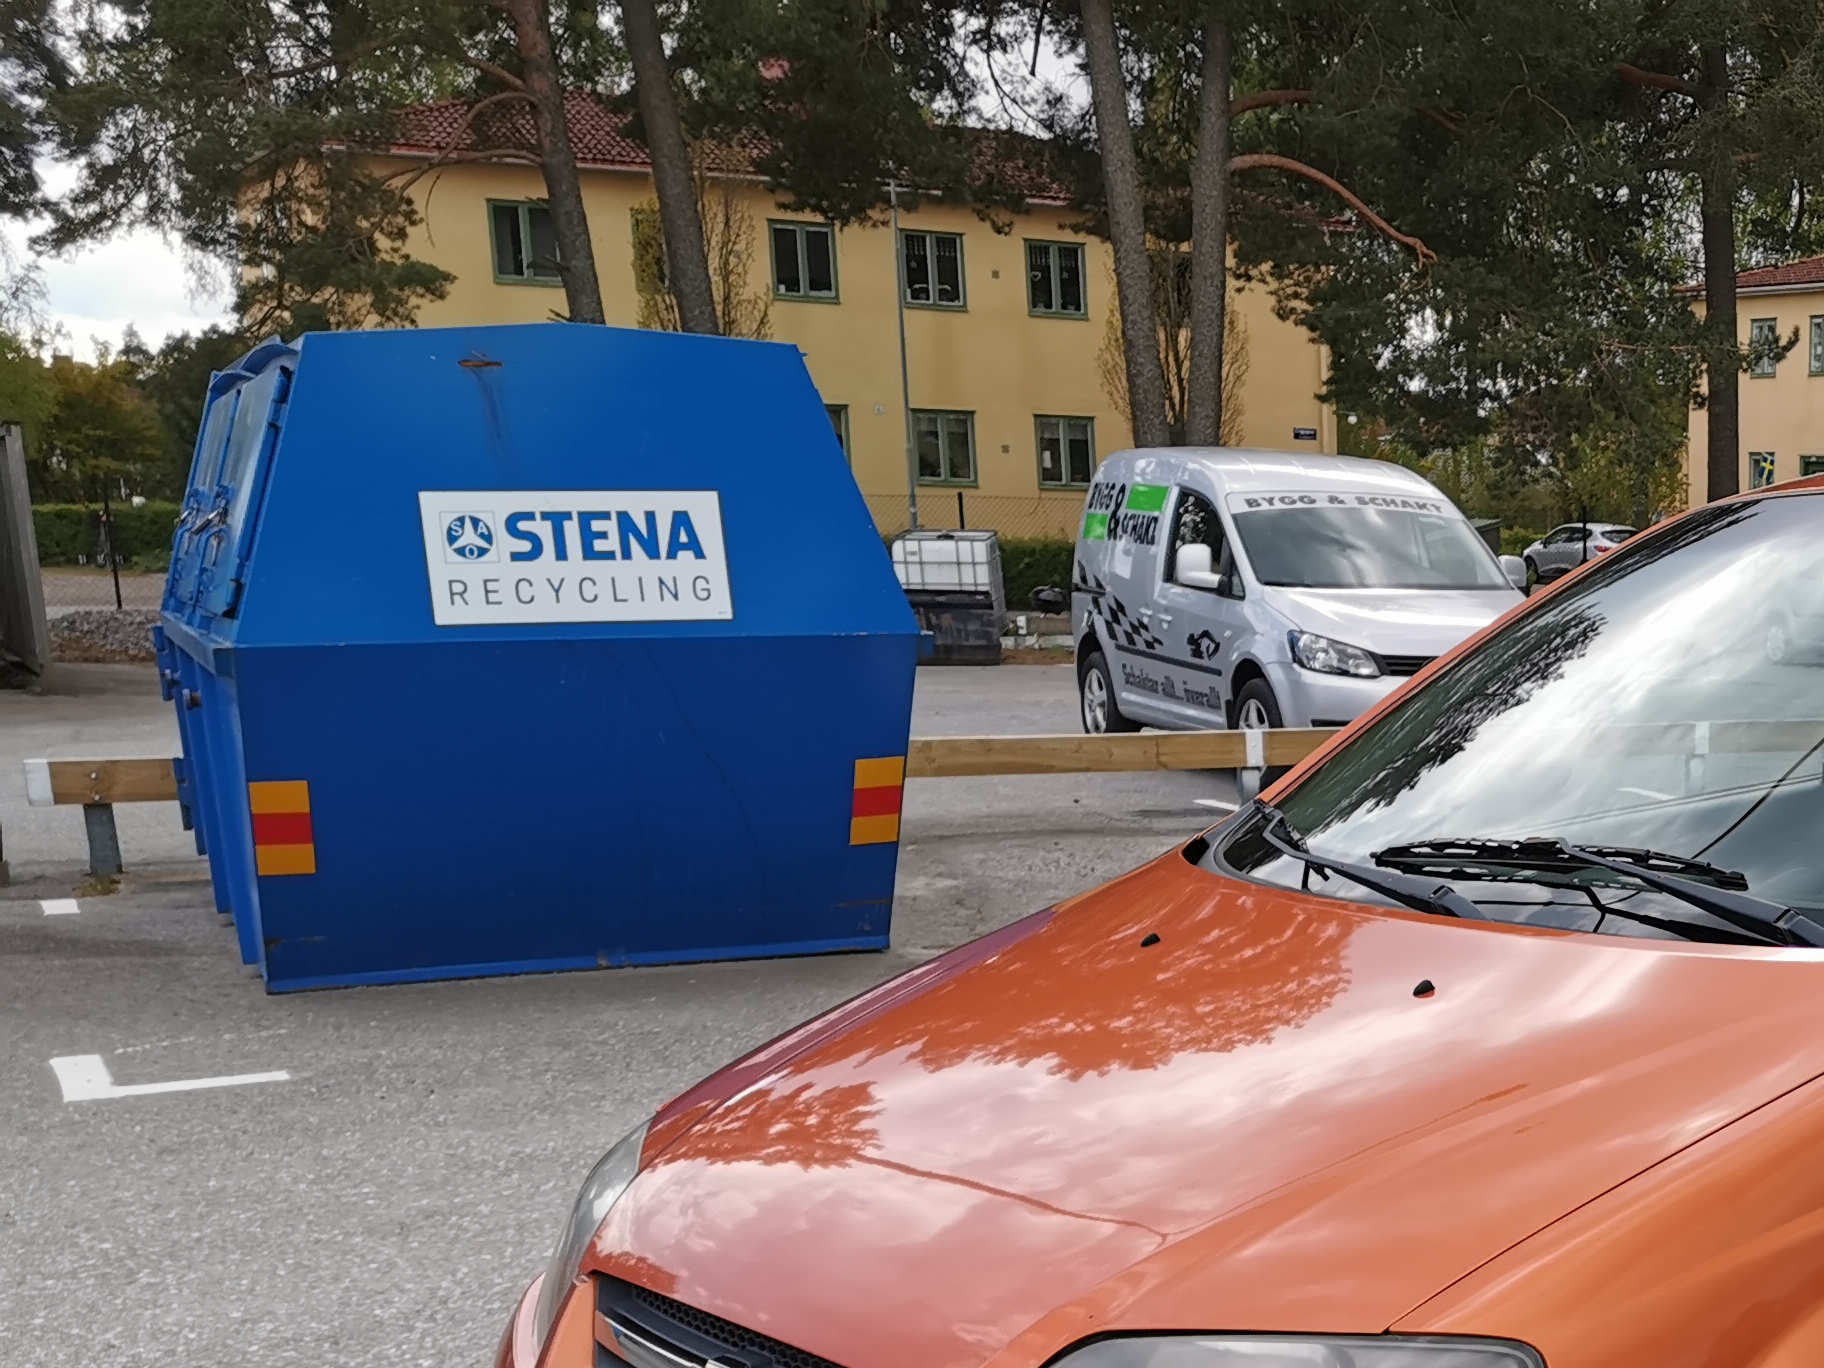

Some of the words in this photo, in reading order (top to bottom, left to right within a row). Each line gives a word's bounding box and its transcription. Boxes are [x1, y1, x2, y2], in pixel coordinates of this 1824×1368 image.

[1244, 494, 1317, 508] BYGG
[1326, 494, 1348, 506] &
[1354, 495, 1444, 514] SCHAKT
[504, 510, 707, 562] STENA
[447, 575, 713, 606] RECYCLING
